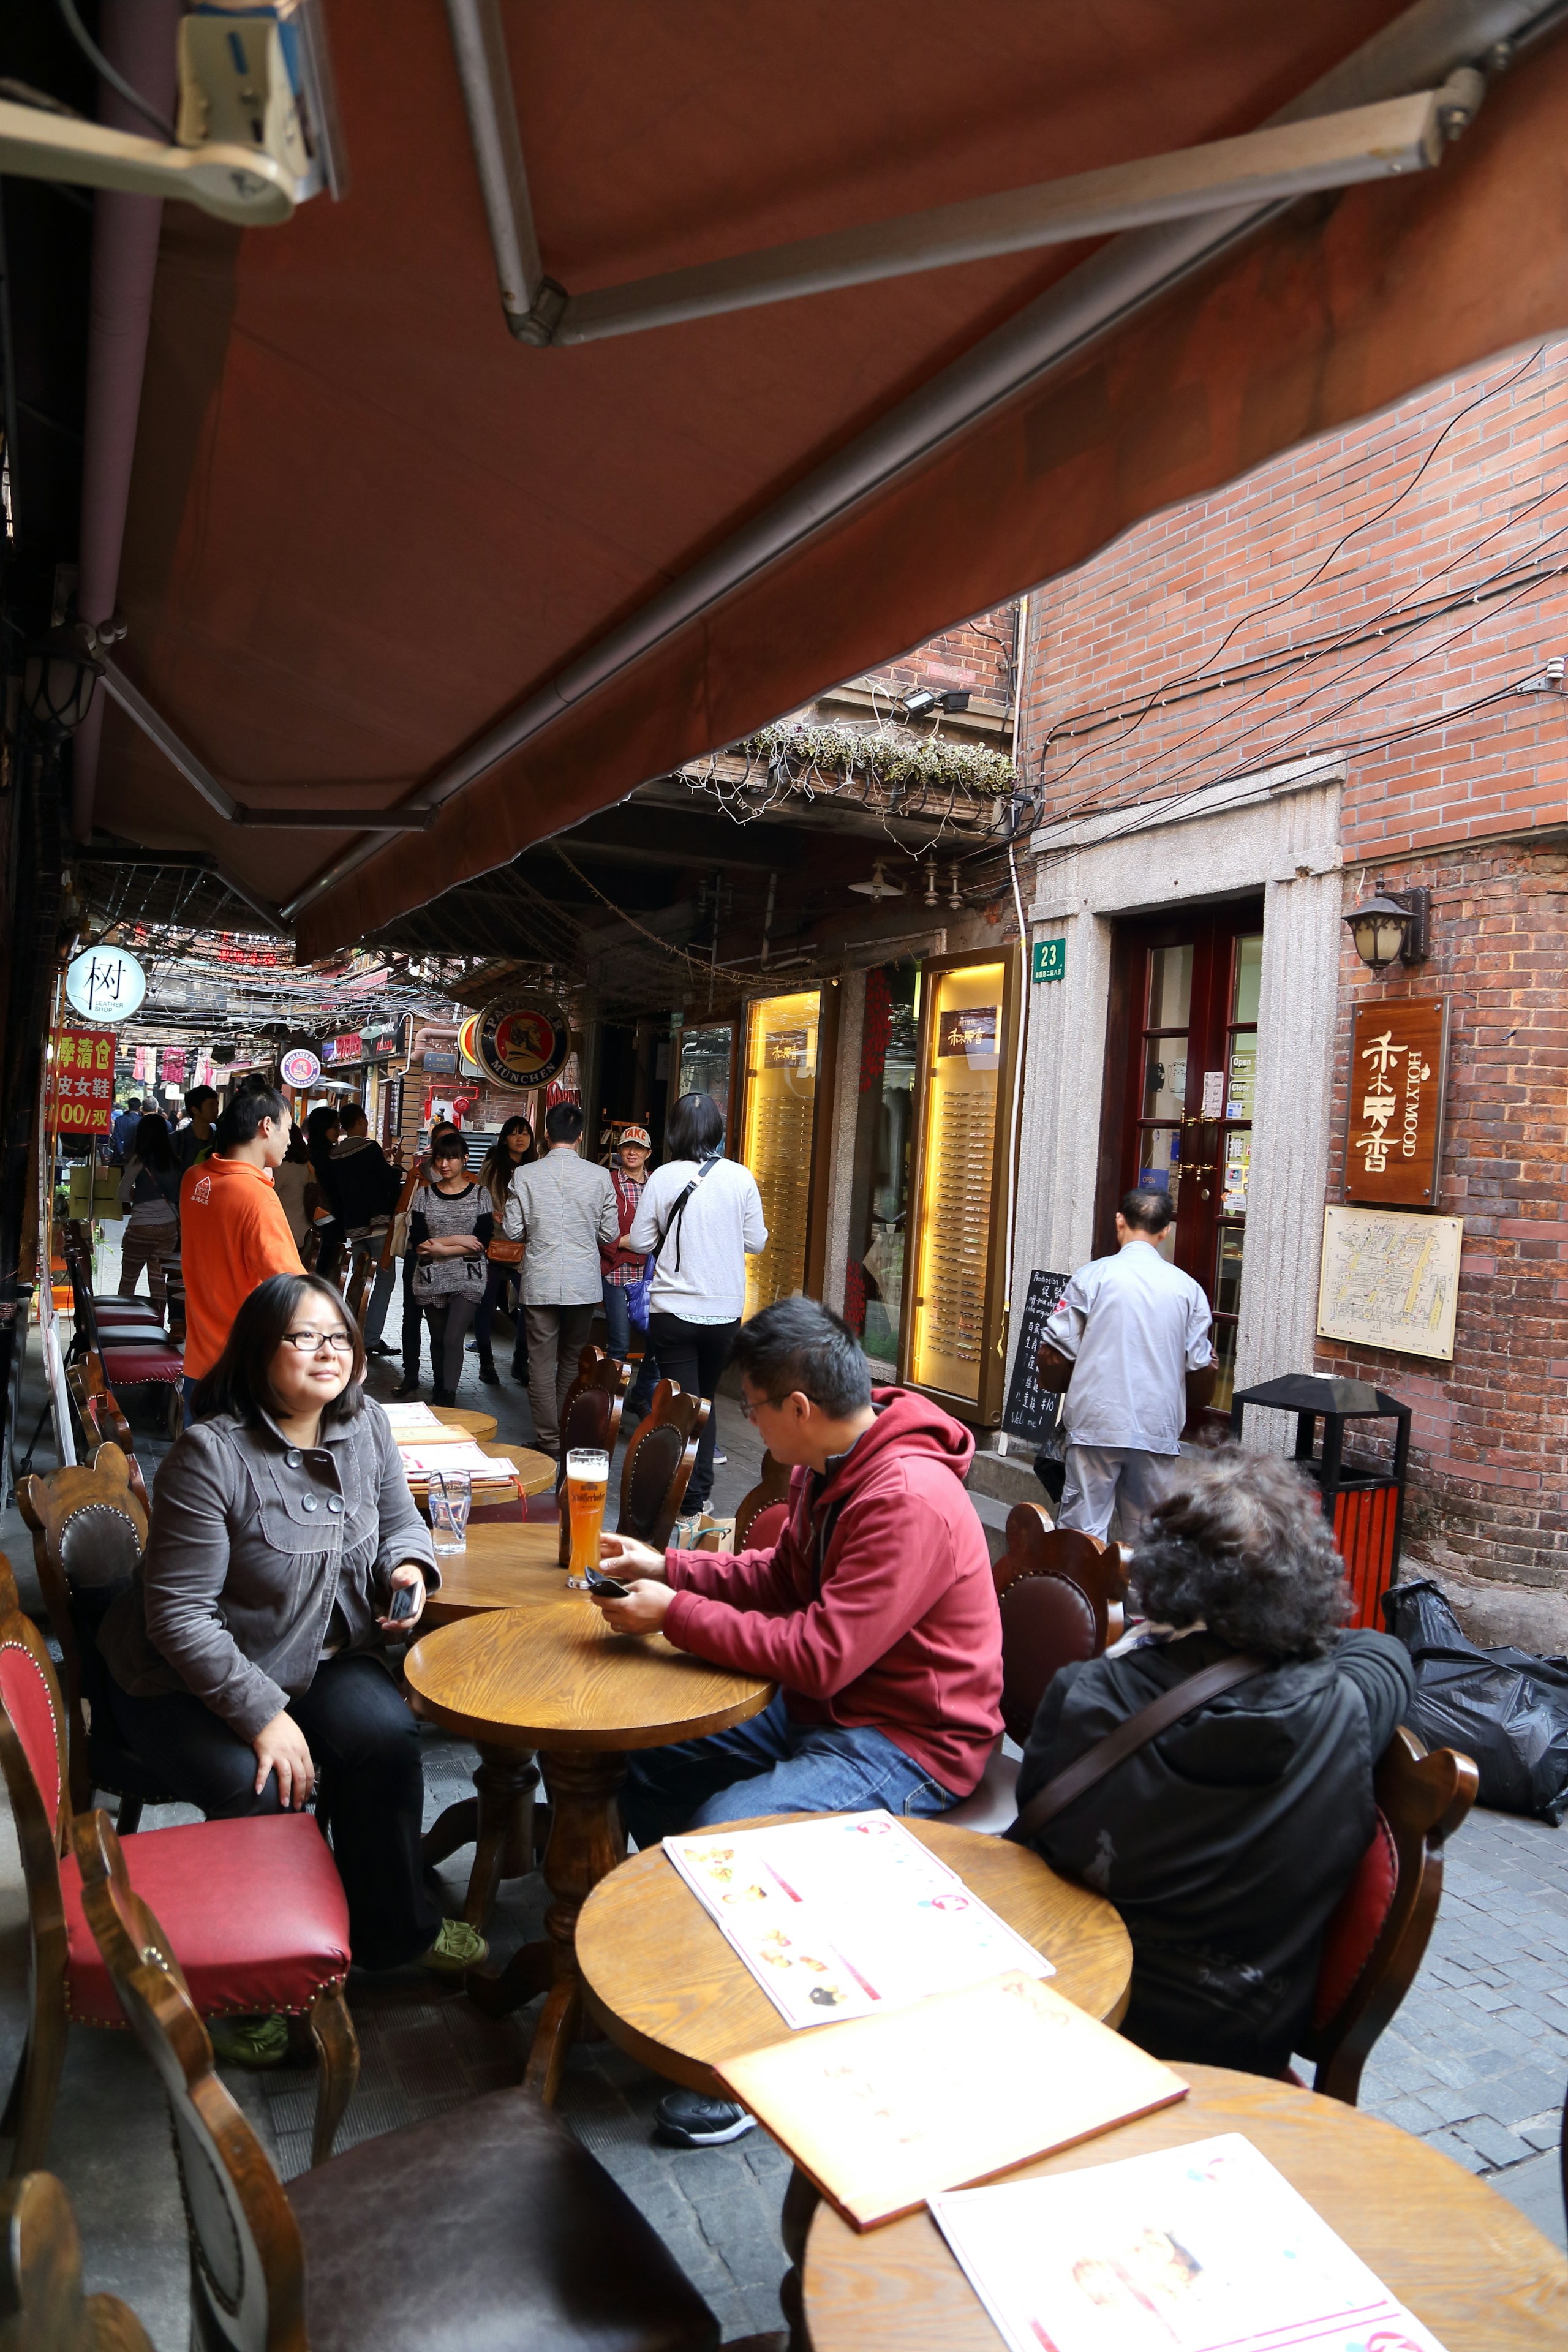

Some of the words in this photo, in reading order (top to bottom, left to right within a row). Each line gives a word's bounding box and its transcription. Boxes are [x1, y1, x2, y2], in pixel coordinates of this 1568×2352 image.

[1041, 944, 1057, 967] 23
[83, 956, 127, 1010] 树
[285, 1052, 309, 1066] PAULANER
[308, 1056, 317, 1069] BEER
[1233, 1058, 1251, 1068] Open
[491, 1060, 556, 1084] MÜNCHEN
[625, 1128, 647, 1142] TAKE
[467, 1262, 483, 1280] N
